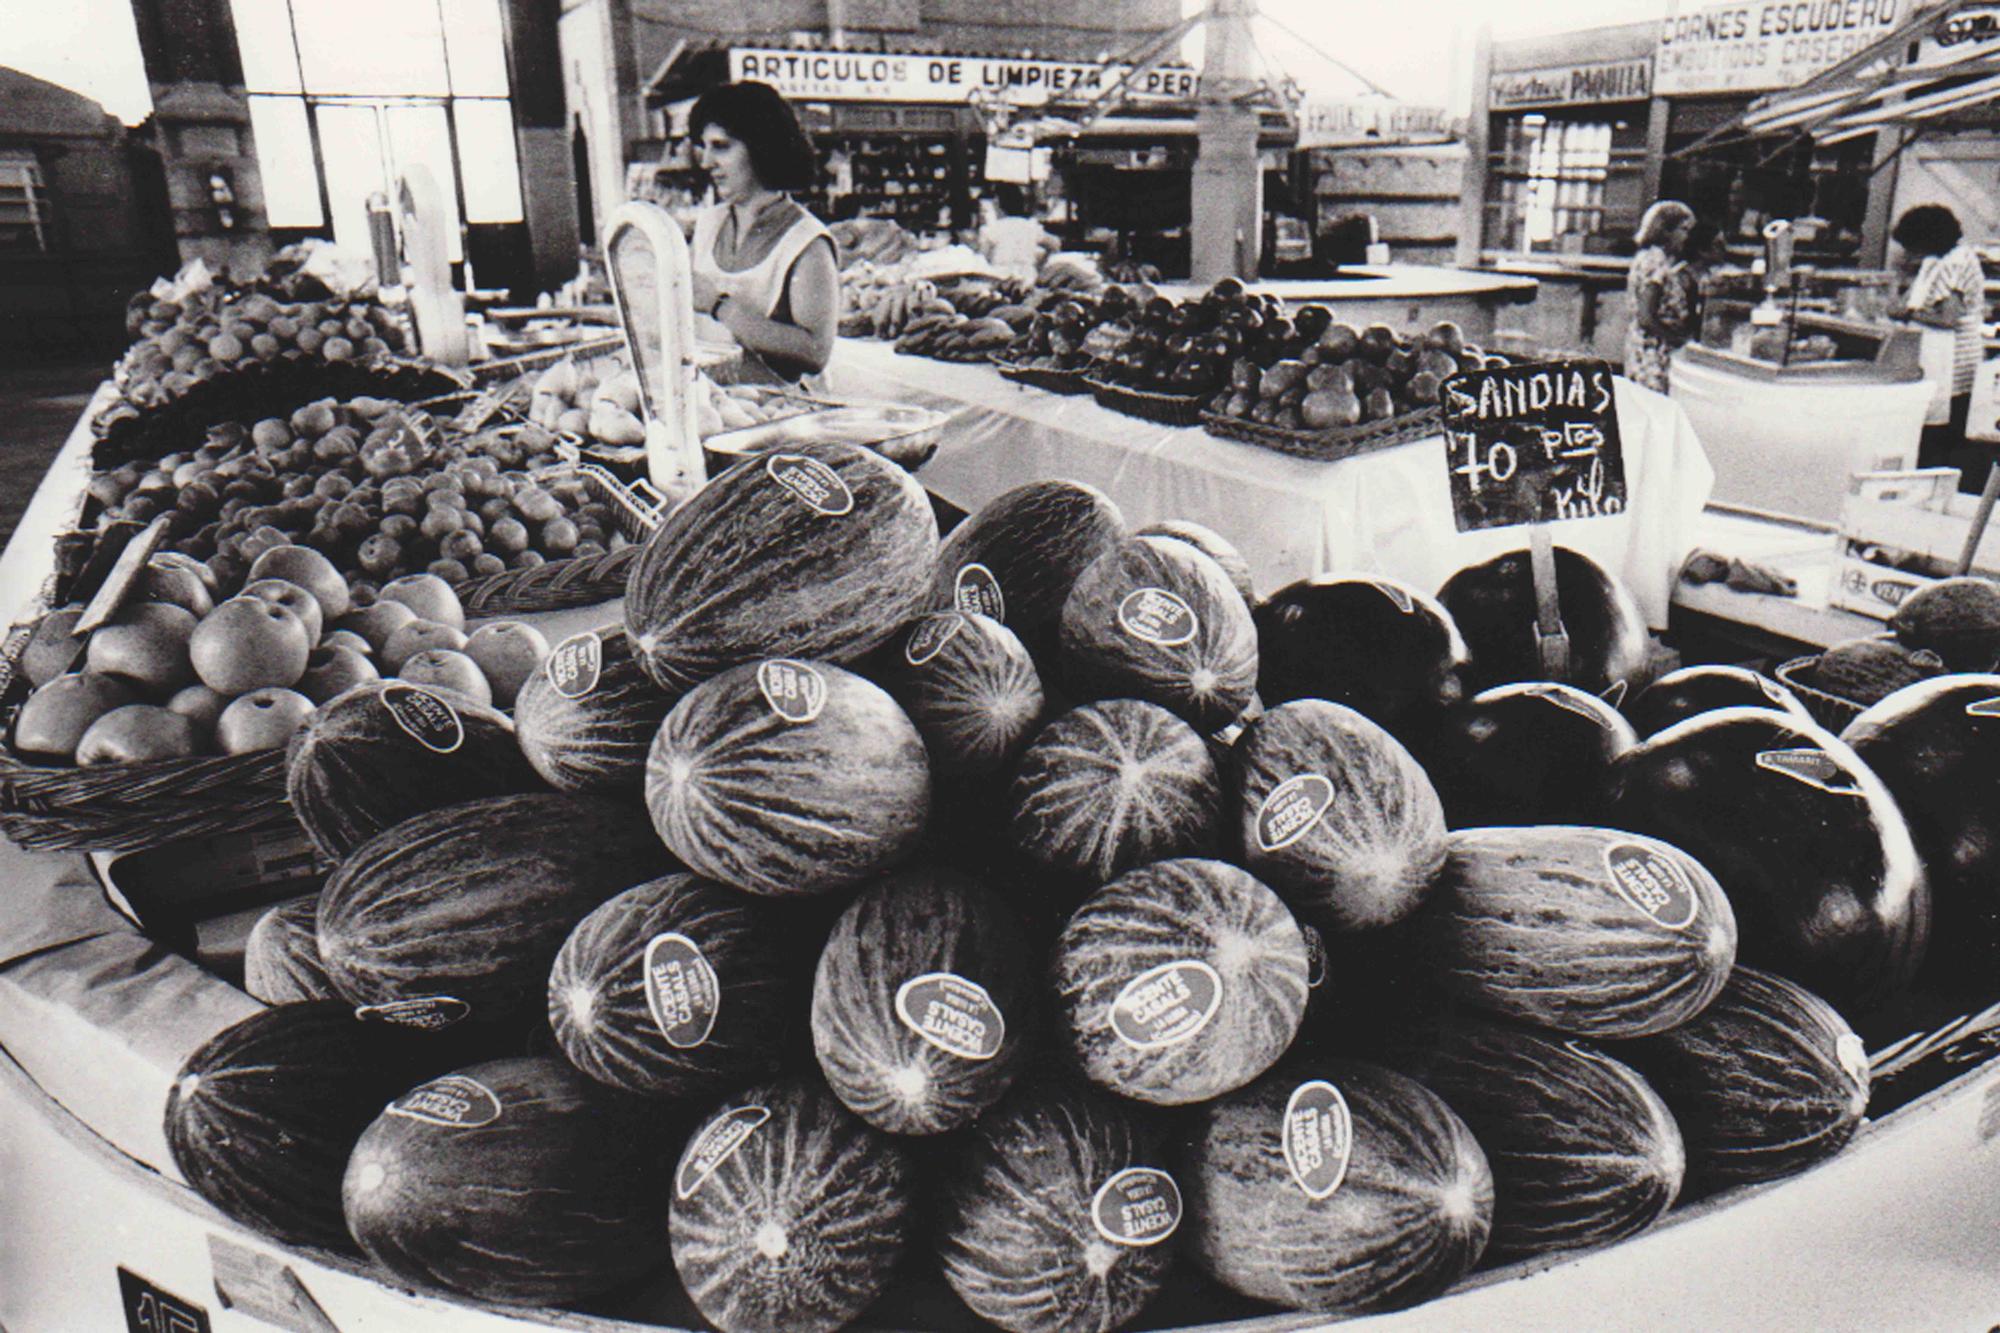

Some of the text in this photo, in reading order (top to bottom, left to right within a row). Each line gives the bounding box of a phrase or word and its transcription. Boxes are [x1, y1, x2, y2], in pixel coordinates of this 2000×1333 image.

[1662, 9, 1749, 45] CARNES
[1759, 0, 1896, 37] ESCUDERO
[742, 55, 907, 82] ARTICULOS
[929, 61, 962, 84] DE
[983, 65, 1101, 89] LIMPIEZA
[1446, 370, 1610, 419] SANDIAS
[1611, 860, 1661, 915] VICENTE
[1623, 854, 1672, 907] CASALS
[650, 962, 682, 1031] VICENTE
[663, 959, 695, 1024] CASALS
[921, 1013, 983, 1053] VICENTE
[926, 998, 987, 1037] CASALS
[1290, 1109, 1311, 1178] VICENTE
[1118, 1195, 1167, 1221] CASALS
[1122, 1210, 1173, 1237] VICENTE
